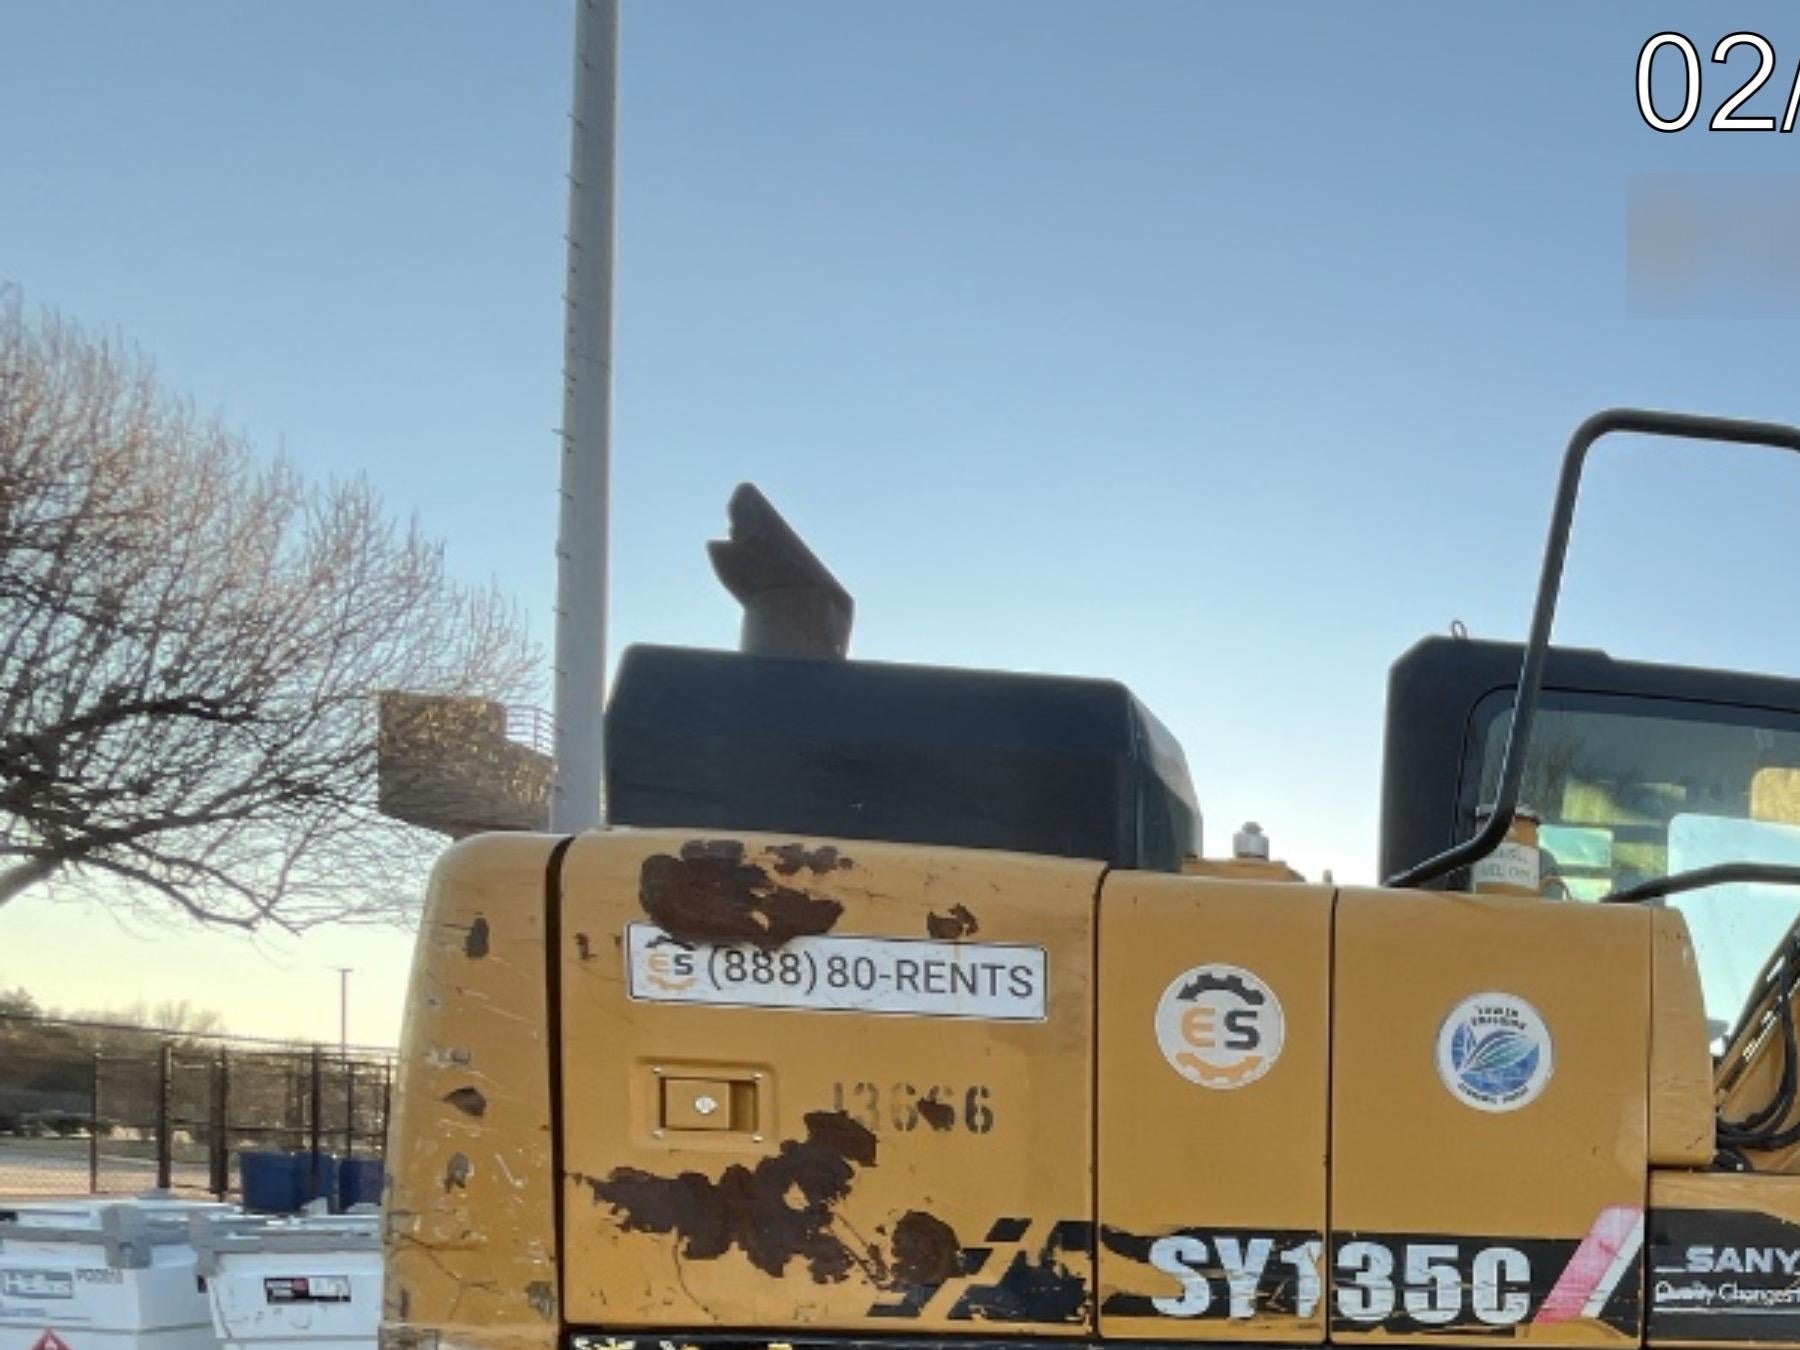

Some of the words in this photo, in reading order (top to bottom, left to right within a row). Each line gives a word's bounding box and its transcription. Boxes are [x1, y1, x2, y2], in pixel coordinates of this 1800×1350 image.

[707, 946, 818, 996] (888)
[826, 956, 1034, 999] 80-RENTS
[1182, 1007, 1260, 1050] ES
[1149, 1235, 1531, 1325] SY135C
